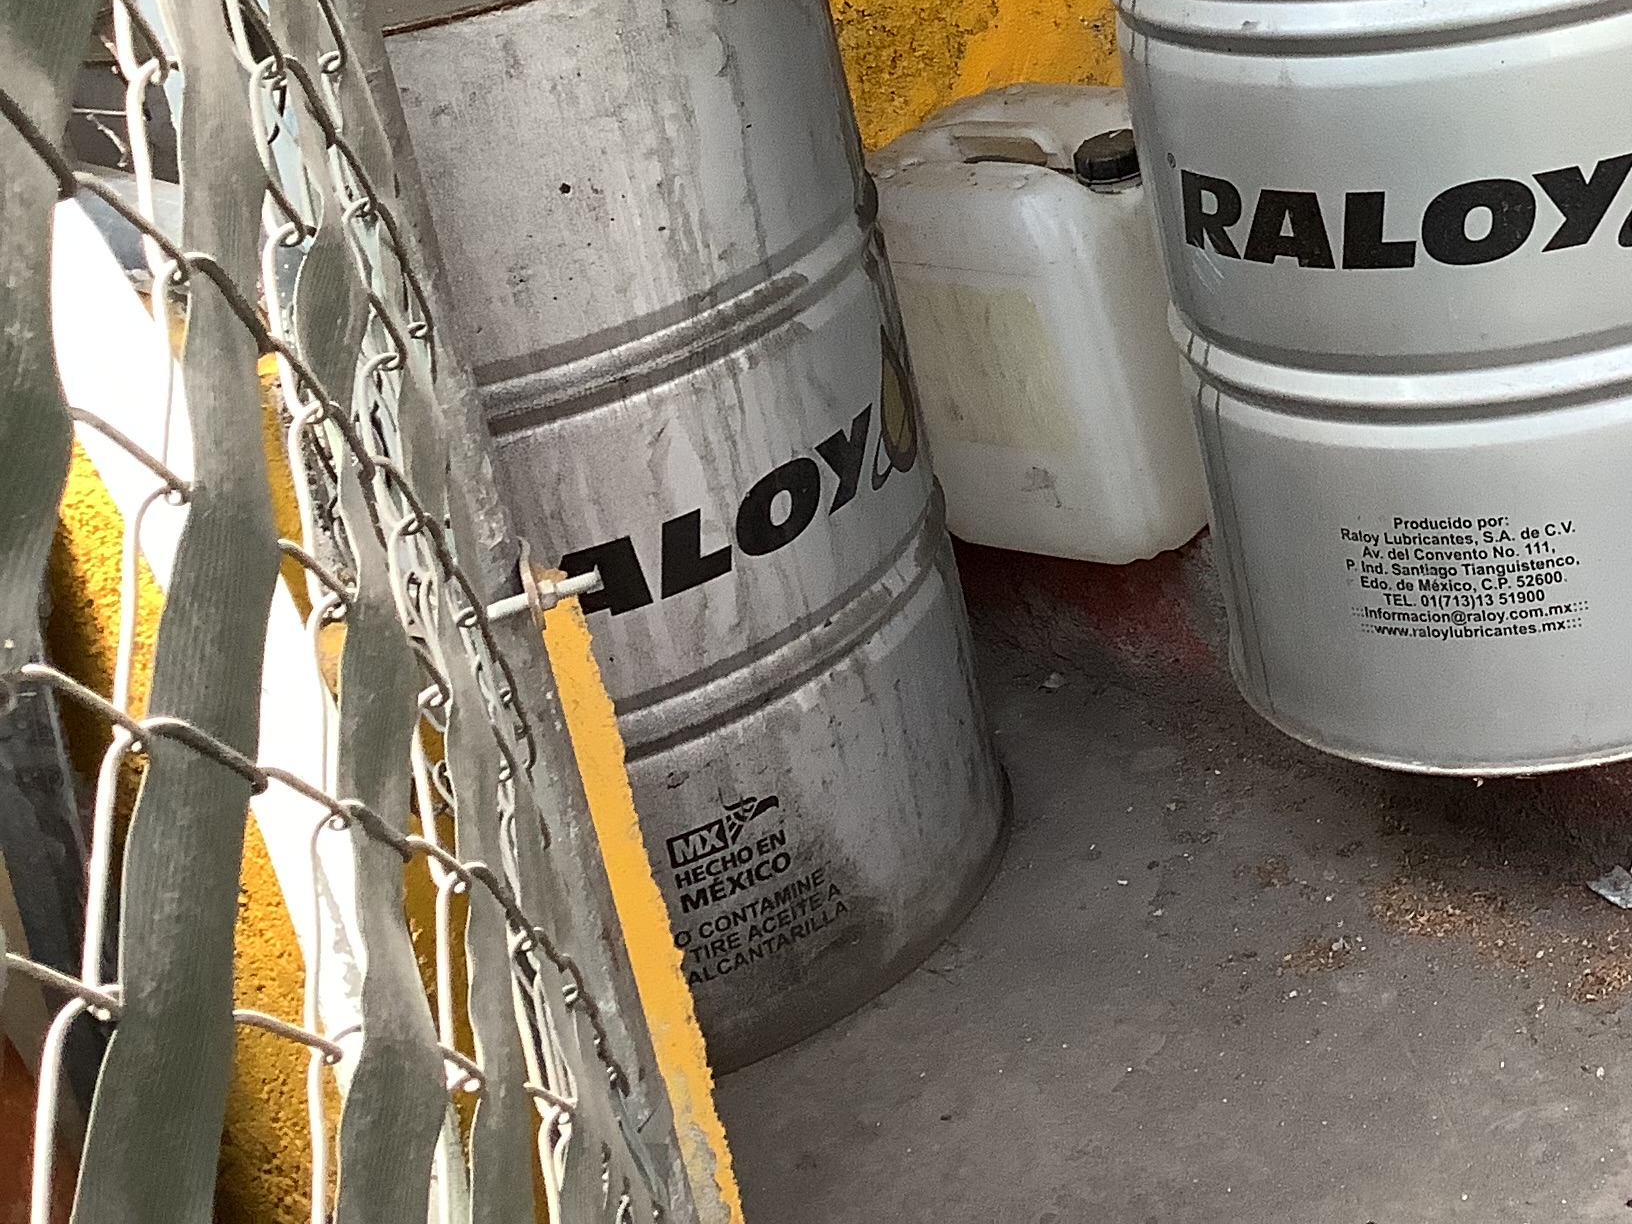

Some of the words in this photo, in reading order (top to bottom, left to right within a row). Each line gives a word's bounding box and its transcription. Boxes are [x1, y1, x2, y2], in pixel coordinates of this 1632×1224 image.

[558, 403, 873, 616] ALOY
[1393, 517, 1472, 530] Producido
[1477, 516, 1509, 530] por:
[1340, 528, 1379, 546] Raloy
[1384, 532, 1479, 546] Lubricantes,
[1483, 530, 1515, 543] S.A.
[1520, 527, 1540, 540] de
[1544, 521, 1576, 537] C.V.
[1362, 546, 1384, 559] Av.
[1388, 548, 1409, 560] del
[1414, 548, 1488, 561] Convento
[1493, 545, 1519, 559] No.
[1524, 541, 1556, 555] 111,
[1346, 559, 1358, 571] P.
[1361, 561, 1388, 575] Ind.
[1392, 563, 1457, 579] Santiago
[1360, 576, 1391, 590] Edo.
[1396, 580, 1414, 591] de
[1418, 579, 1477, 593] México,
[1481, 578, 1511, 591] C.P.
[1383, 593, 1417, 606] TEL.
[1420, 593, 1494, 610] 01(713)13
[1499, 589, 1545, 605] 51900
[672, 825, 725, 865] MX
[675, 846, 753, 889] HECHO
[756, 829, 786, 856] EN
[680, 852, 791, 914] MÉXICO
[674, 931, 692, 950] O
[699, 868, 825, 940] CONTAMINE
[688, 932, 742, 964] TIRE
[748, 892, 823, 942] ACEITE
[827, 883, 842, 902] A
[686, 901, 849, 989] ALCANTARILLA
